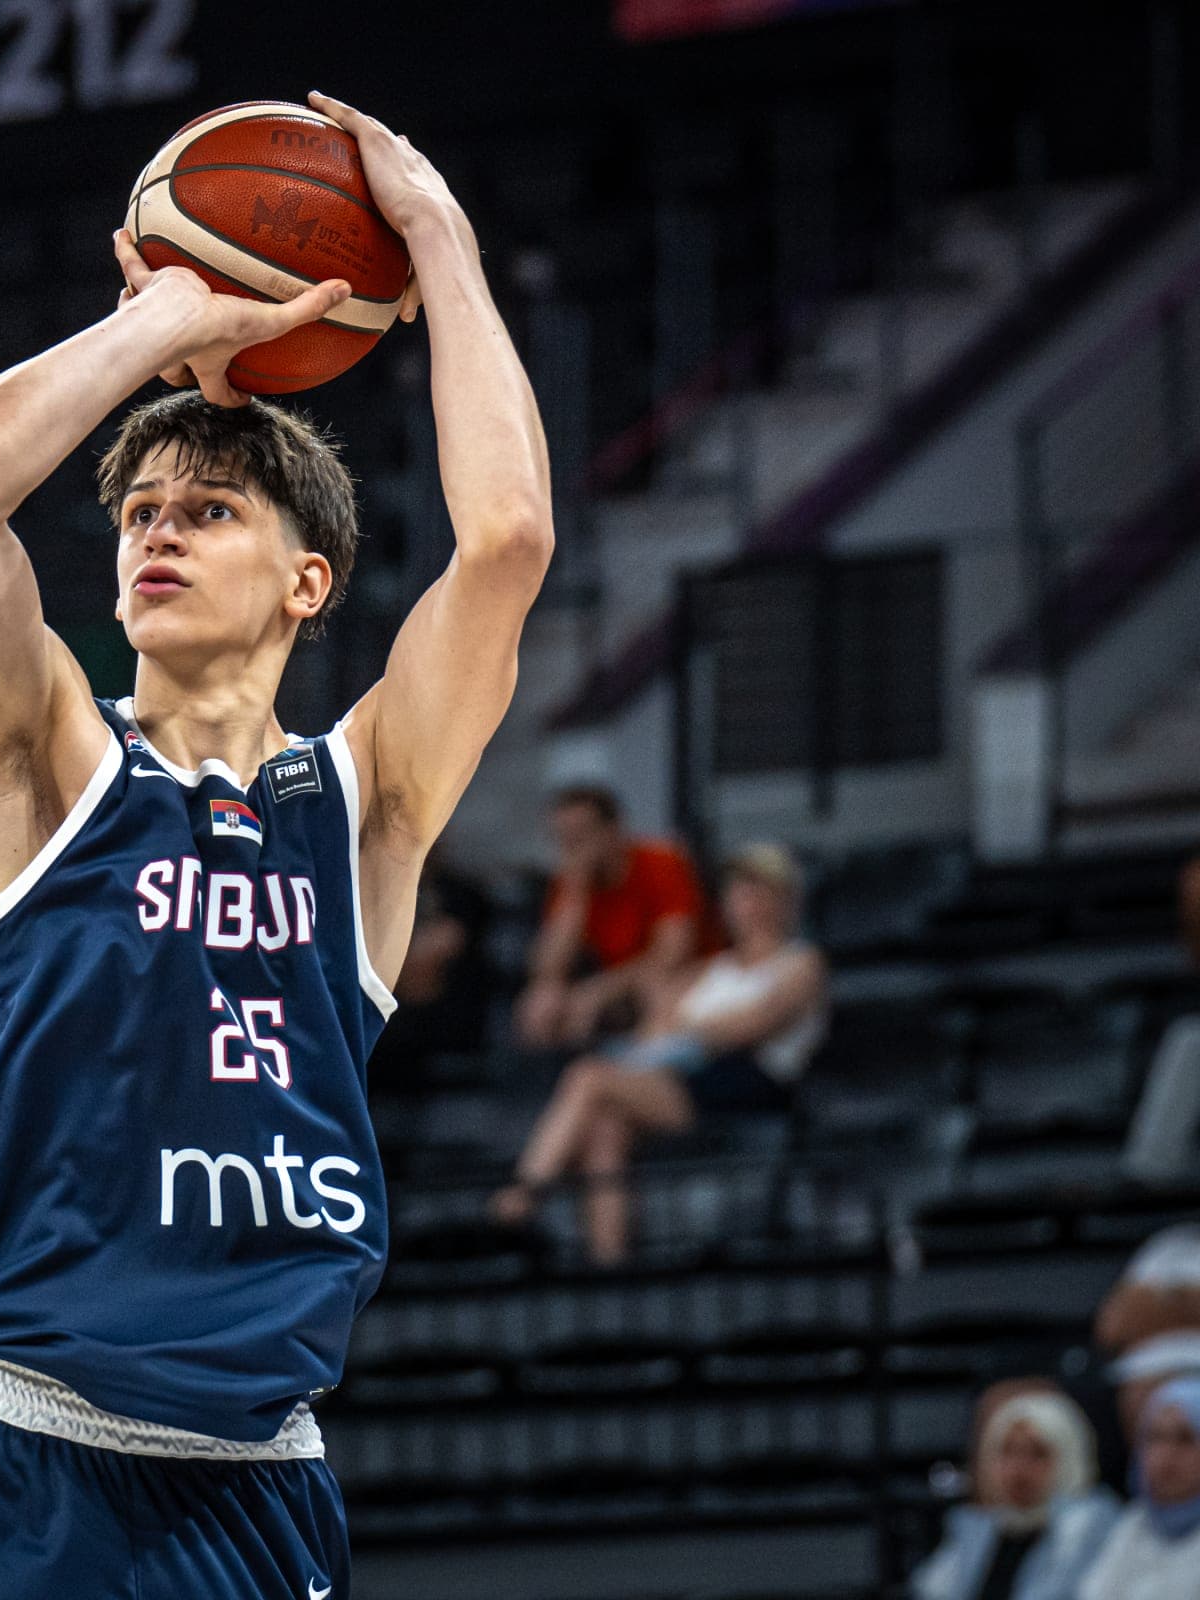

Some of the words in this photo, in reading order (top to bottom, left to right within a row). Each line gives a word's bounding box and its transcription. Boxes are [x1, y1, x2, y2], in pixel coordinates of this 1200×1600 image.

[275, 760, 309, 780] FIBA
[210, 985, 292, 1091] 25
[160, 1133, 366, 1233] mts
